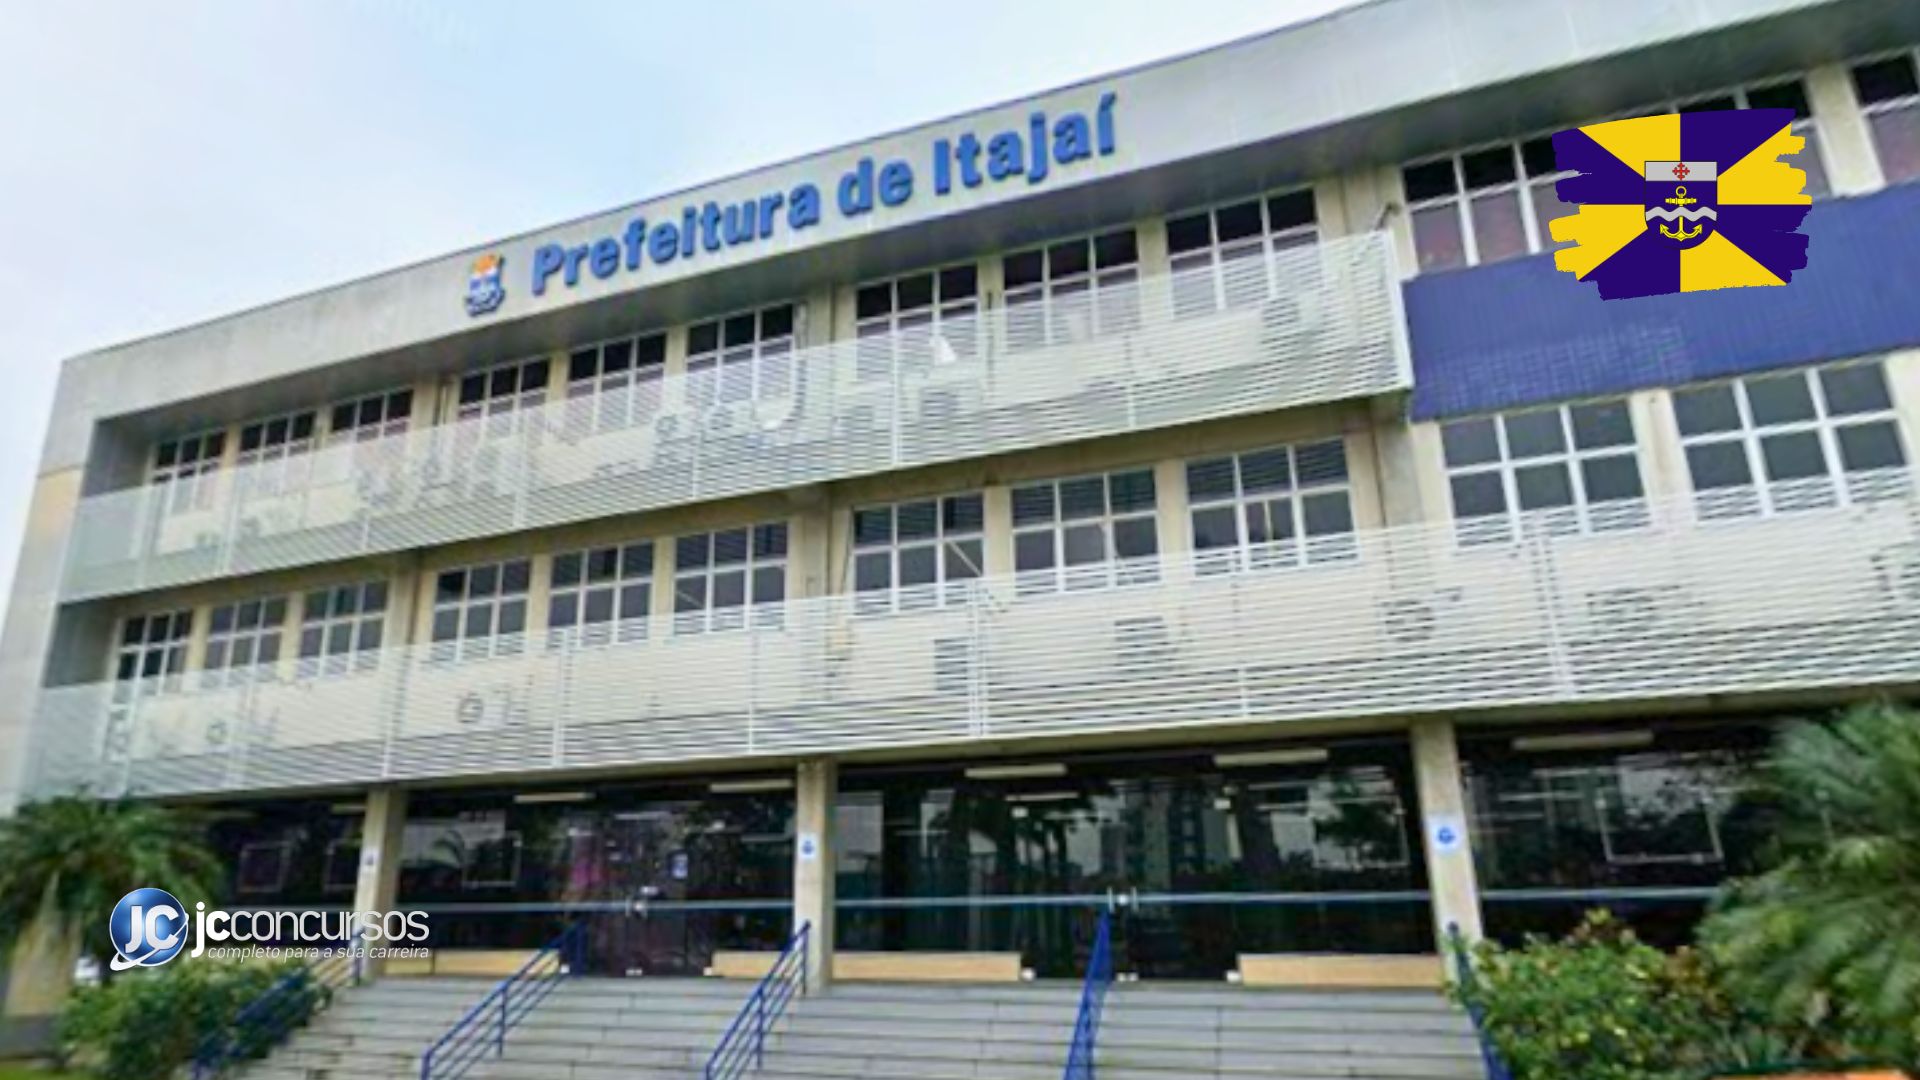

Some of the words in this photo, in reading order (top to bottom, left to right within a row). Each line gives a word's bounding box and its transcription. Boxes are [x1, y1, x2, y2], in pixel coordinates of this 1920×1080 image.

[531, 182, 819, 296] Prefeitura
[836, 157, 913, 218] de
[933, 93, 1118, 197] Itajaí
